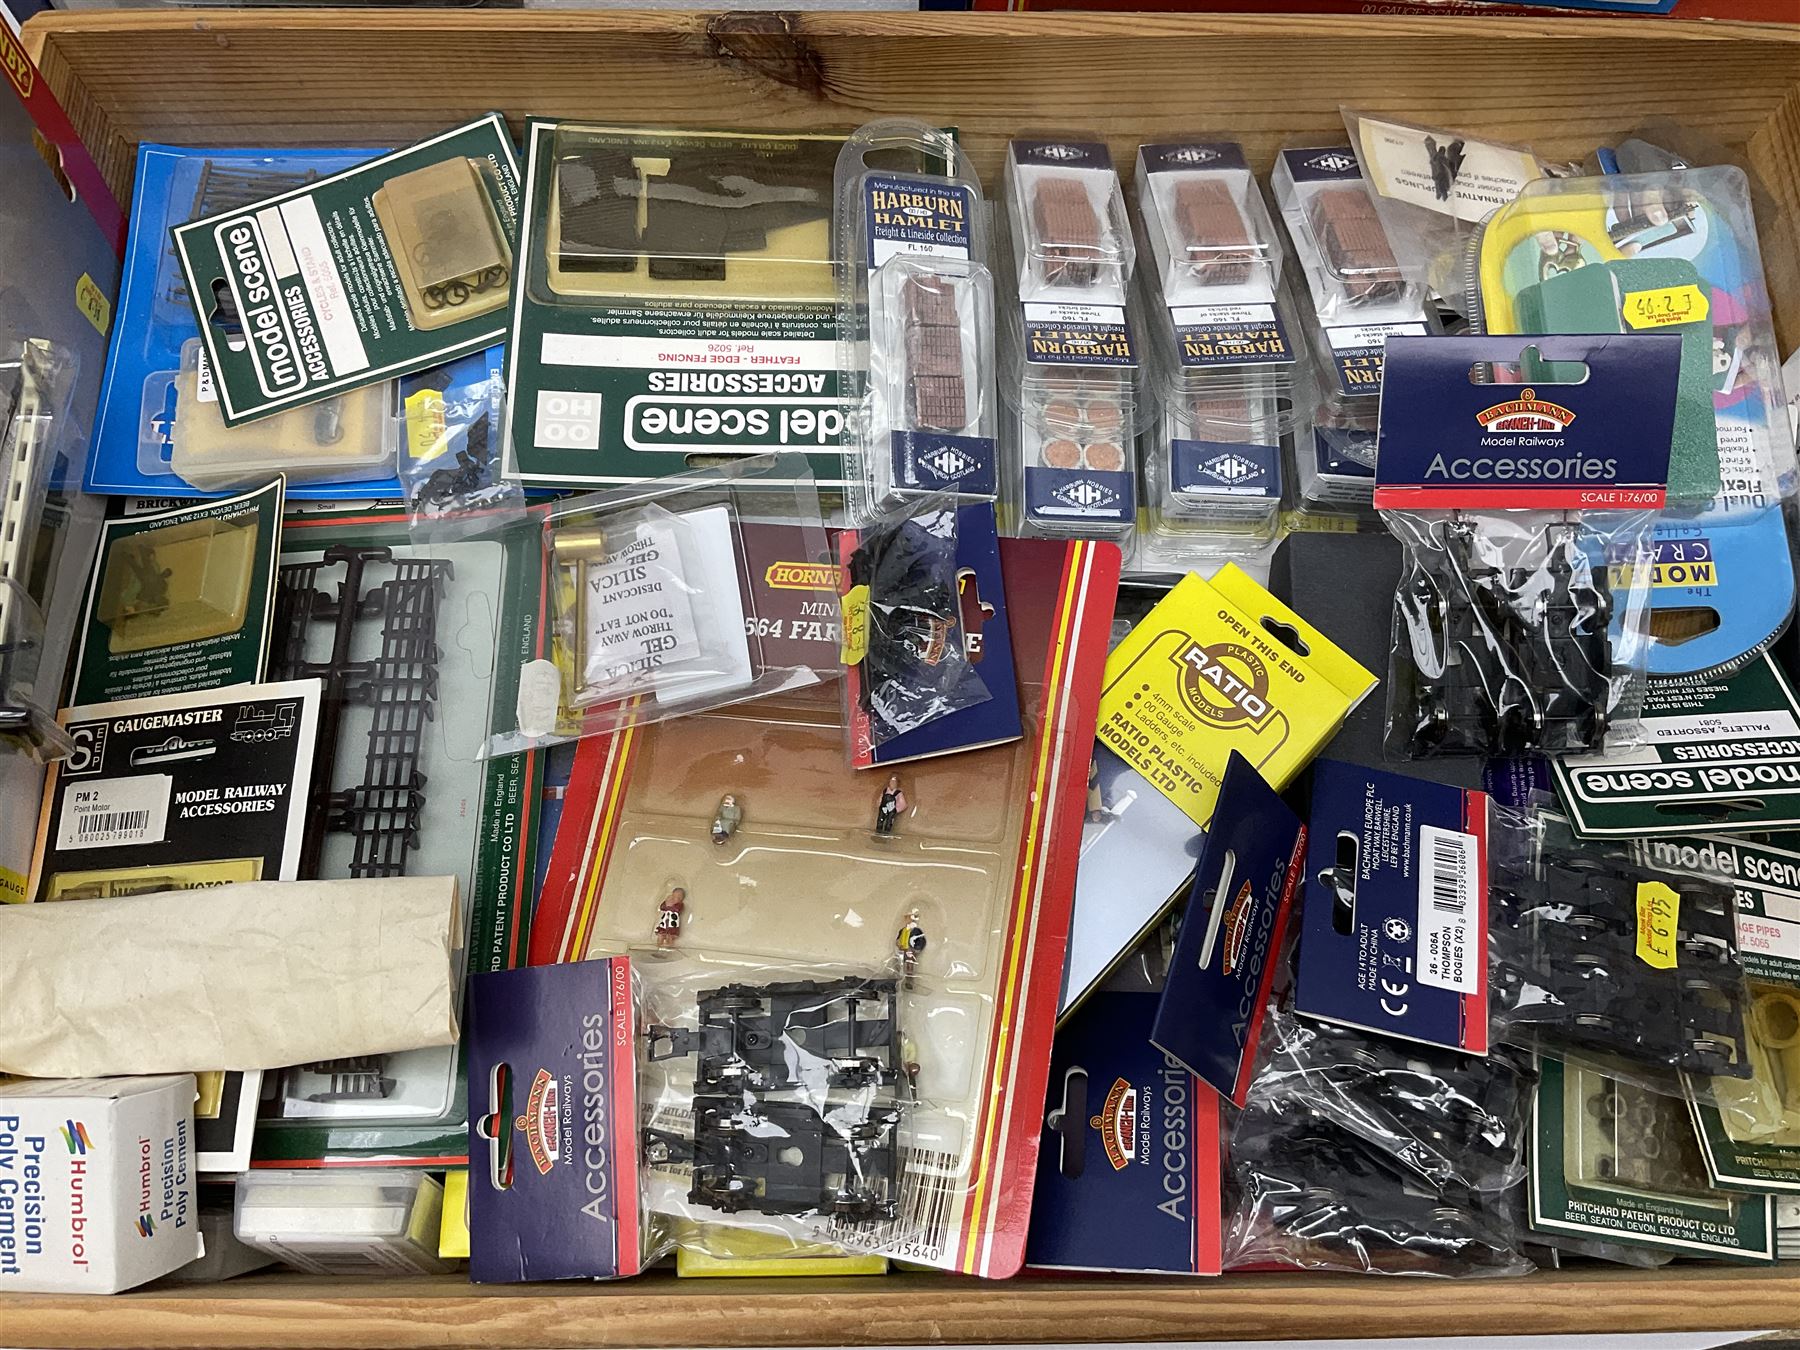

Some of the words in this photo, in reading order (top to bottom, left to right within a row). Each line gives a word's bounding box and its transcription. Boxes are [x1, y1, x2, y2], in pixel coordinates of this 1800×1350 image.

[873, 192, 962, 219] HARBURN
[874, 226, 898, 238] Freight
[900, 228, 906, 237] &
[907, 229, 934, 240] Lineside
[935, 232, 967, 244] Collection
[875, 213, 965, 232] HAMLET
[226, 225, 271, 305] scene
[282, 284, 329, 383] ACCESSORIES
[656, 327, 695, 335] collectors.
[783, 330, 814, 338] Detailed
[1030, 330, 1126, 341] HAMLET
[1182, 330, 1278, 342] HAMLET
[246, 303, 297, 388] model
[657, 352, 707, 362] FENCING
[707, 343, 731, 352] 5026
[734, 344, 754, 352] Ref.
[1032, 339, 1130, 355] HARBURN
[1184, 339, 1284, 355] HARBURN
[709, 354, 739, 363] EDGE
[750, 355, 800, 364] FEATHER
[647, 370, 825, 394] ACCESSORIES
[640, 406, 769, 435] scene
[1484, 401, 1568, 421] BACHMANN
[1481, 437, 1515, 445] Model
[1518, 436, 1564, 446] Railways
[950, 446, 975, 464] HOBBIES
[1424, 452, 1616, 478] Accessories
[1580, 492, 1615, 502] SCALE
[1618, 492, 1657, 503] 1:76/00
[623, 548, 659, 565] GEL
[588, 565, 646, 593] SILICA
[774, 567, 841, 585] HORNB
[601, 581, 662, 603] DESICCANT
[1687, 588, 1711, 596] The
[623, 611, 648, 625] NOT
[631, 620, 672, 637] THROW
[521, 614, 531, 654] ENGLAND
[599, 630, 629, 646] AWAY
[639, 633, 677, 654] GEL
[788, 620, 839, 642] FAR
[1216, 609, 1249, 638] OPEN
[1249, 636, 1279, 662] THIS
[1279, 660, 1305, 683] END
[1227, 645, 1264, 677] PLASTIC
[1183, 644, 1268, 720] RATIO
[1152, 692, 1172, 711] 4mm
[1174, 711, 1195, 730] scale
[1188, 686, 1224, 719] MODELS
[112, 708, 223, 733] GAUGEMASTER
[1155, 712, 1182, 737] Gauge
[1656, 726, 1715, 736] ASSORTED
[1721, 722, 1769, 732] PALLETS,
[1099, 723, 1152, 771] MODELS
[1149, 767, 1178, 793] LTD
[1110, 711, 1150, 748] RATIO
[1147, 743, 1203, 795] PLASTIC
[1134, 710, 1171, 743] Ladders,
[1171, 741, 1186, 755] etc.
[1186, 754, 1222, 787] included
[173, 788, 220, 804] MODEL
[223, 782, 287, 800] RAILWAY
[494, 773, 506, 806] England
[508, 775, 518, 804] BEER,
[1366, 783, 1374, 796] PLC
[1586, 769, 1693, 793] scene
[73, 804, 90, 813] Point
[91, 802, 110, 811] Motor
[74, 792, 91, 802] PM
[92, 791, 99, 799] 2
[179, 798, 275, 818] ACCESSORIES
[504, 813, 514, 833] LTD
[1365, 799, 1374, 828] EUROPE
[1391, 806, 1399, 840] ENGLAND
[78, 831, 109, 843] 060025
[490, 818, 500, 841] Made
[1401, 803, 1412, 876] www.bachmann.co.uk
[502, 836, 512, 851] CO
[1362, 830, 1372, 878] BACHMANN
[1389, 856, 1397, 867] LE9
[497, 855, 510, 906] PRODUCT
[1282, 872, 1296, 903] SCALE
[493, 909, 505, 952] PATENT
[1234, 944, 1248, 979] Model
[1243, 898, 1260, 943] Railways
[1359, 923, 1368, 948] ADULT
[1370, 929, 1378, 954] CHINA
[1453, 925, 1465, 943] (X2)
[1755, 923, 1780, 936] PIPES
[1231, 857, 1286, 1045] Accessories
[1359, 950, 1366, 960] TO
[1428, 931, 1439, 954] 006A
[1439, 926, 1451, 979] THOMPSON
[1370, 956, 1376, 964] IN
[1428, 963, 1437, 974] 36
[1452, 945, 1464, 982] BOGIES
[615, 966, 625, 1005] 1:76/00
[616, 1009, 626, 1045] SCALE
[561, 1075, 572, 1123] Railways
[1142, 1086, 1150, 1128] Railways
[526, 1077, 548, 1164] BACHMANN
[580, 1013, 607, 1222] Accessories
[1107, 1082, 1126, 1166] BACHMANN
[0, 1115, 20, 1168] Poly
[563, 1127, 573, 1164] Model
[1140, 1131, 1149, 1164] Model
[1156, 1050, 1187, 1222] Accessorie
[175, 1118, 189, 1188] Cement
[138, 1136, 151, 1213] Humbrol
[161, 1136, 175, 1222] Precision
[23, 1136, 47, 1253] Precision
[1615, 1198, 1635, 1208] Made
[1644, 1202, 1674, 1215] England
[69, 1159, 87, 1265] Humbrol
[176, 1190, 189, 1229] Poly
[1567, 1200, 1619, 1217] PRITCHARD
[1620, 1209, 1653, 1222] PATENT
[1656, 1214, 1699, 1230] PRODUCT
[1701, 1221, 1715, 1232] CO
[1716, 1224, 1735, 1236] LTD
[0, 1178, 21, 1274] Cement
[1590, 1215, 1624, 1228] SEATON,
[1659, 1226, 1680, 1236] EX12
[1700, 1233, 1739, 1246] ENGLAND
